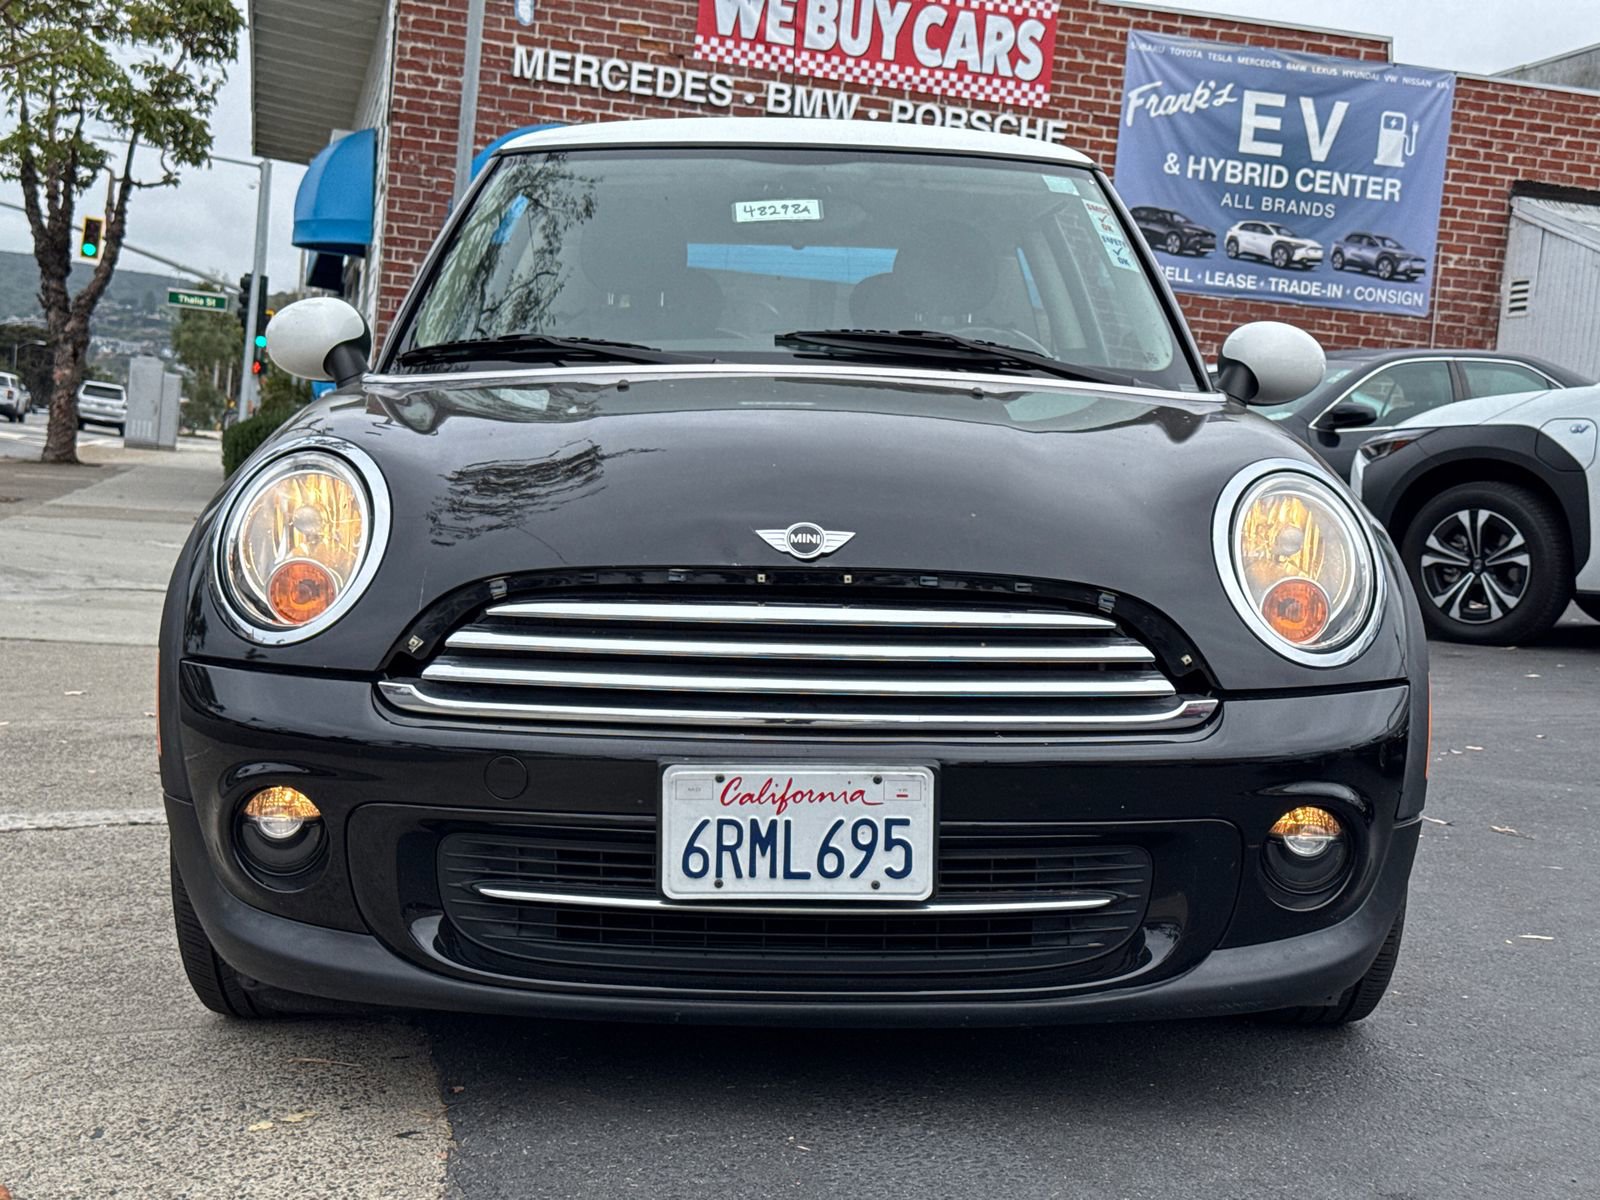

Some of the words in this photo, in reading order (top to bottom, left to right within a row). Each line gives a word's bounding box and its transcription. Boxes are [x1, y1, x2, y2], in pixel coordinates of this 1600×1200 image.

[713, 0, 796, 46] WE
[803, 0, 912, 61] BUY
[912, 10, 1047, 82] CARS
[1170, 47, 1203, 59] TOYOTA
[1208, 52, 1232, 63] TESLA
[1237, 56, 1282, 69] MERCEDES
[1312, 66, 1338, 76] LEXUS
[1342, 70, 1380, 82] HYUNDAI
[1384, 75, 1398, 84] VW
[1402, 78, 1433, 88] NISSAN
[511, 45, 734, 108] MERCEDES
[766, 81, 861, 119] BMW
[891, 99, 1069, 144] PORSCHE
[1126, 79, 1238, 127] Frank's
[1238, 89, 1350, 162] EV
[1163, 152, 1181, 175] &
[1186, 156, 1290, 190] HYBRID
[1295, 171, 1402, 202] CENTER
[1220, 192, 1255, 211] ALL
[1261, 196, 1336, 219] BRANDS
[206, 296, 216, 307] St
[1160, 265, 1194, 283] ELL
[1204, 270, 1257, 290] LEASE
[1269, 277, 1343, 298] TRADE-IN
[1353, 285, 1425, 307] CONSIGN
[790, 533, 821, 544] MINI
[719, 776, 884, 816] California
[681, 817, 913, 880] 6RML695
